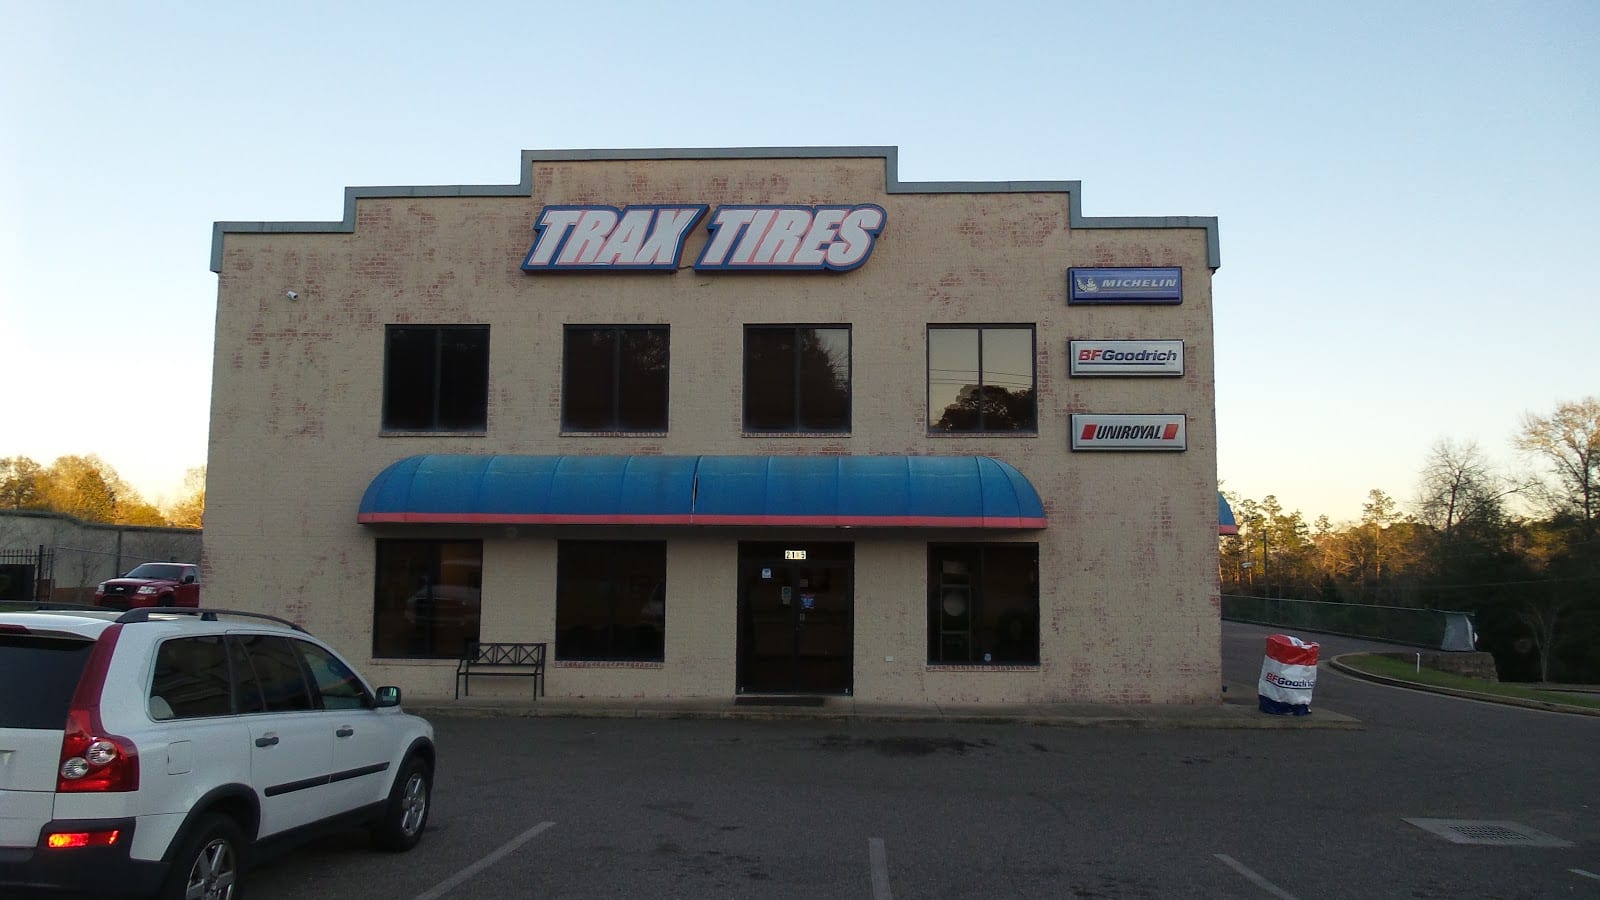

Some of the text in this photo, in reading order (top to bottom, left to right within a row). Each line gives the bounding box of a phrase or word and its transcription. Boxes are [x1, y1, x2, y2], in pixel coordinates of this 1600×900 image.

[525, 208, 883, 267] TRAX TIRES
[1101, 278, 1177, 288] MICHELIN
[1078, 349, 1177, 361] BFGoodrich
[1096, 424, 1162, 440] UNIROYAL
